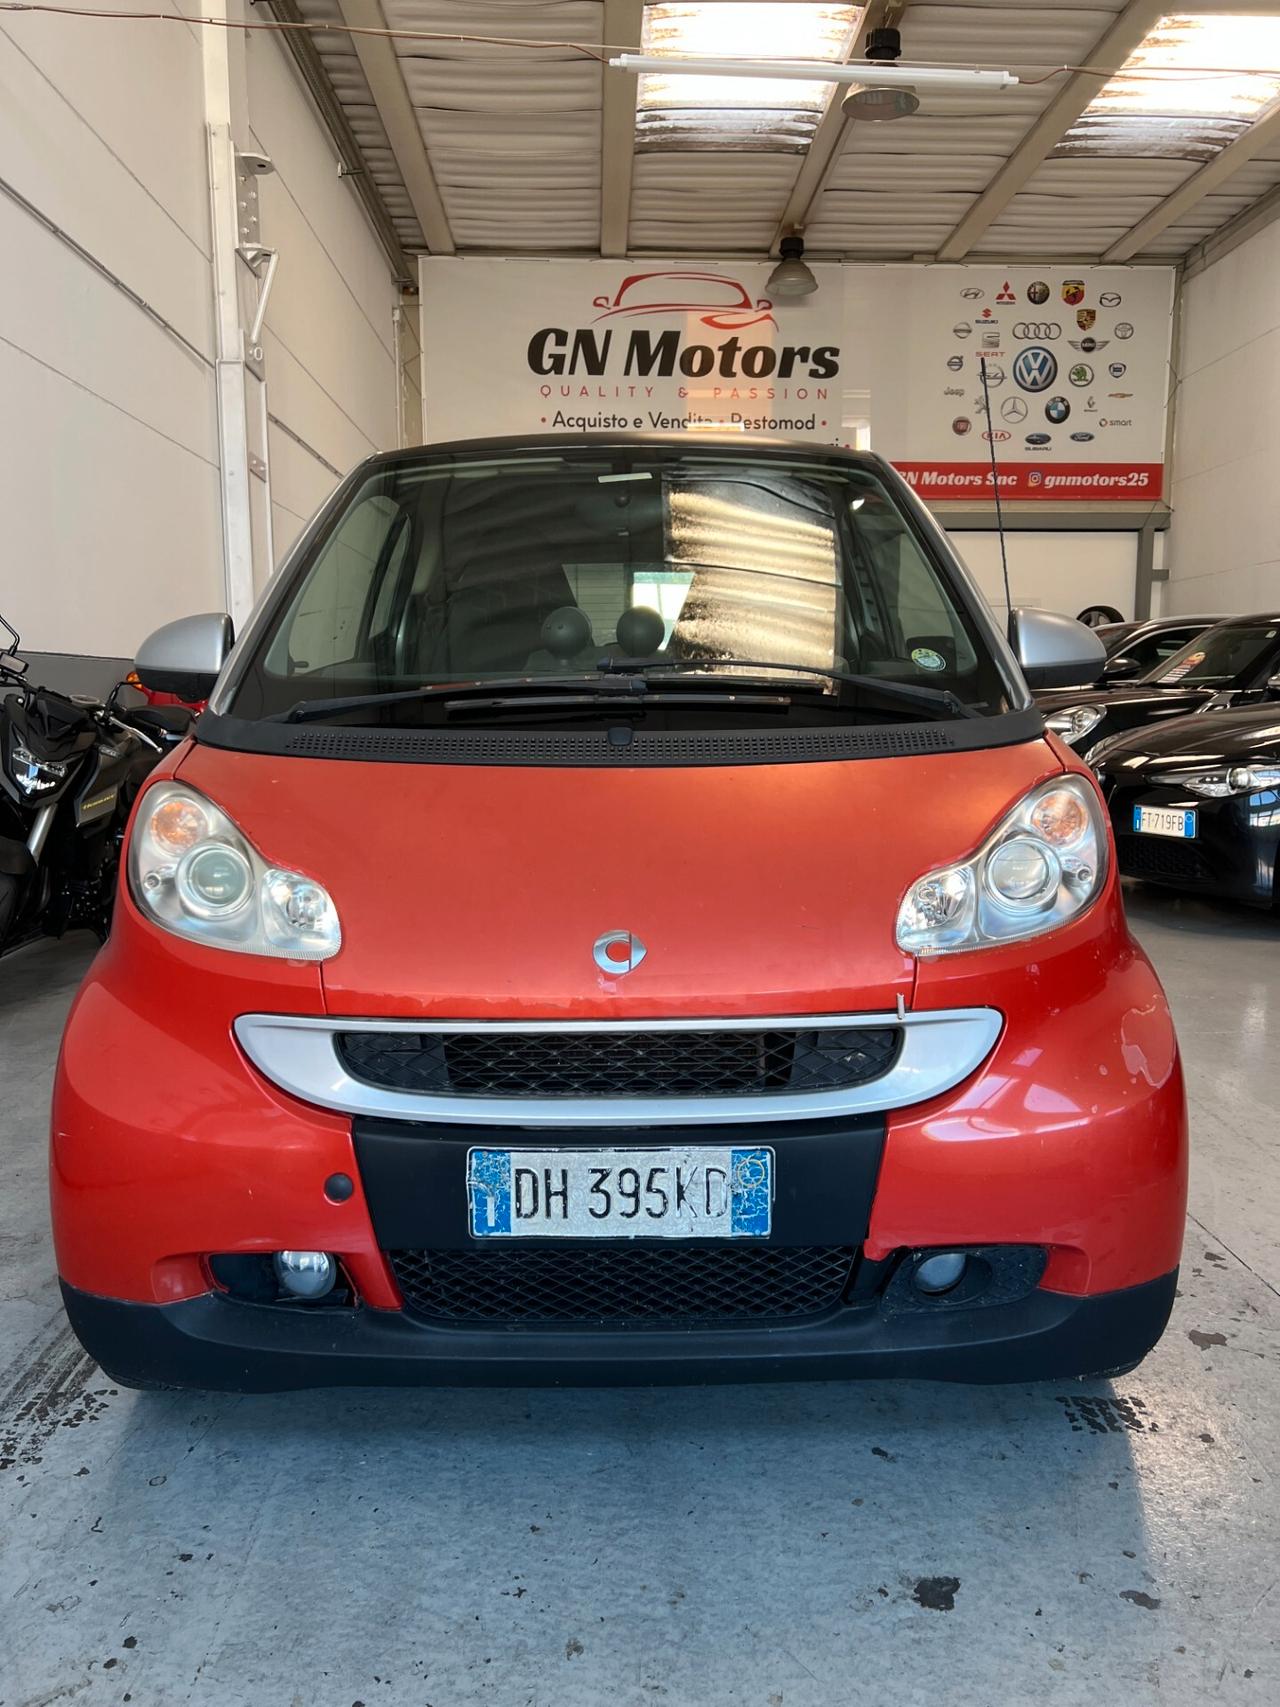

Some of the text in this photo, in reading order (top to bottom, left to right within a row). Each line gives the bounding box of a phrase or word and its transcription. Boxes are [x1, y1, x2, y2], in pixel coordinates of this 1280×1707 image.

[527, 327, 841, 379] GN Motors
[540, 384, 829, 400] QUALITY & PASSION
[552, 411, 629, 432] Acquisto
[632, 416, 643, 429] e
[1109, 419, 1133, 427] smart
[921, 471, 983, 486] Motors
[985, 471, 1018, 486] Snc
[1044, 472, 1149, 489] gnmotors25
[1154, 813, 1184, 831] 719FB
[514, 1168, 569, 1219] DH
[587, 1166, 728, 1219] 395KD
